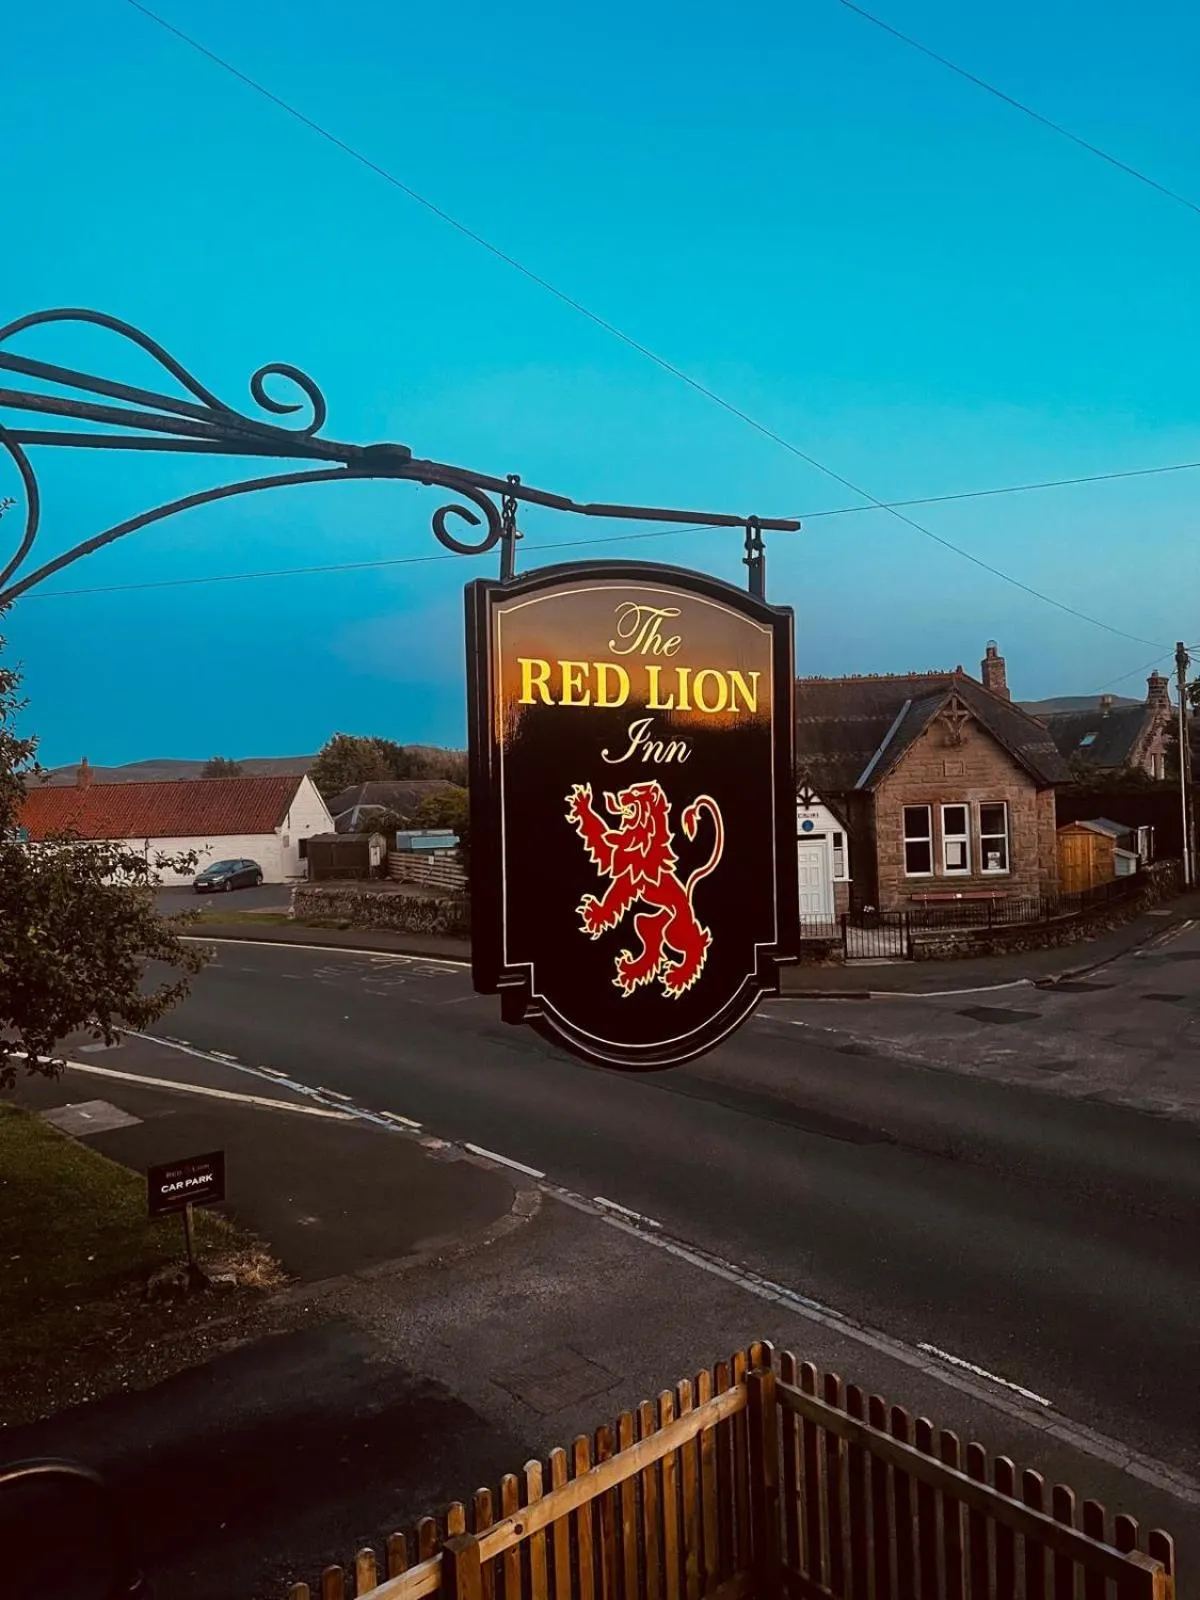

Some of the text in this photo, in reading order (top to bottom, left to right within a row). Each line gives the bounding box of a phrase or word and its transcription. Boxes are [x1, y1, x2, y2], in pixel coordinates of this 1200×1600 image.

[608, 602, 682, 657] The
[517, 658, 761, 713] RED LION
[601, 717, 692, 764] Inn
[161, 1181, 184, 1193] CAR
[185, 1173, 213, 1187] PARK
